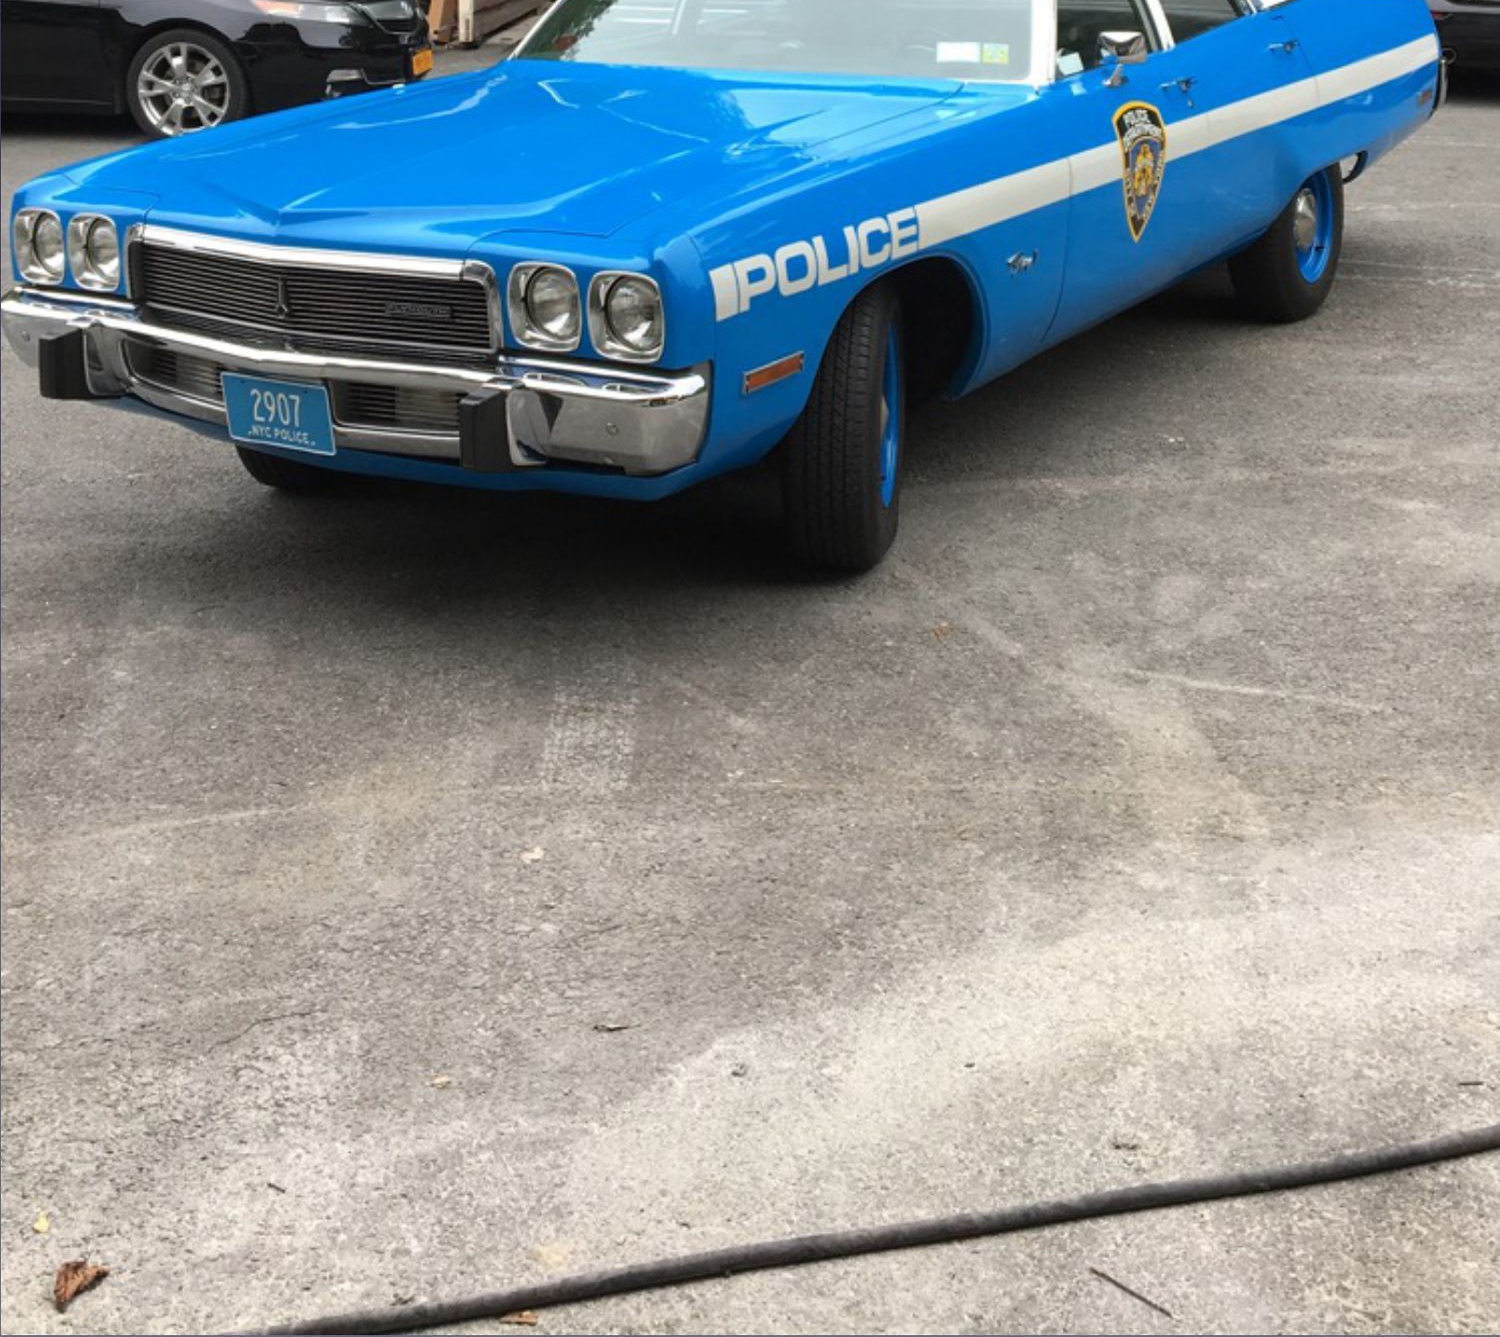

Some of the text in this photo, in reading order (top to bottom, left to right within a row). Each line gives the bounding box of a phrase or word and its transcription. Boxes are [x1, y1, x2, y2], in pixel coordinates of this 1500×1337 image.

[733, 205, 919, 313] POLICE
[250, 388, 300, 428] 2907
[251, 425, 310, 445] NYC POLICE
